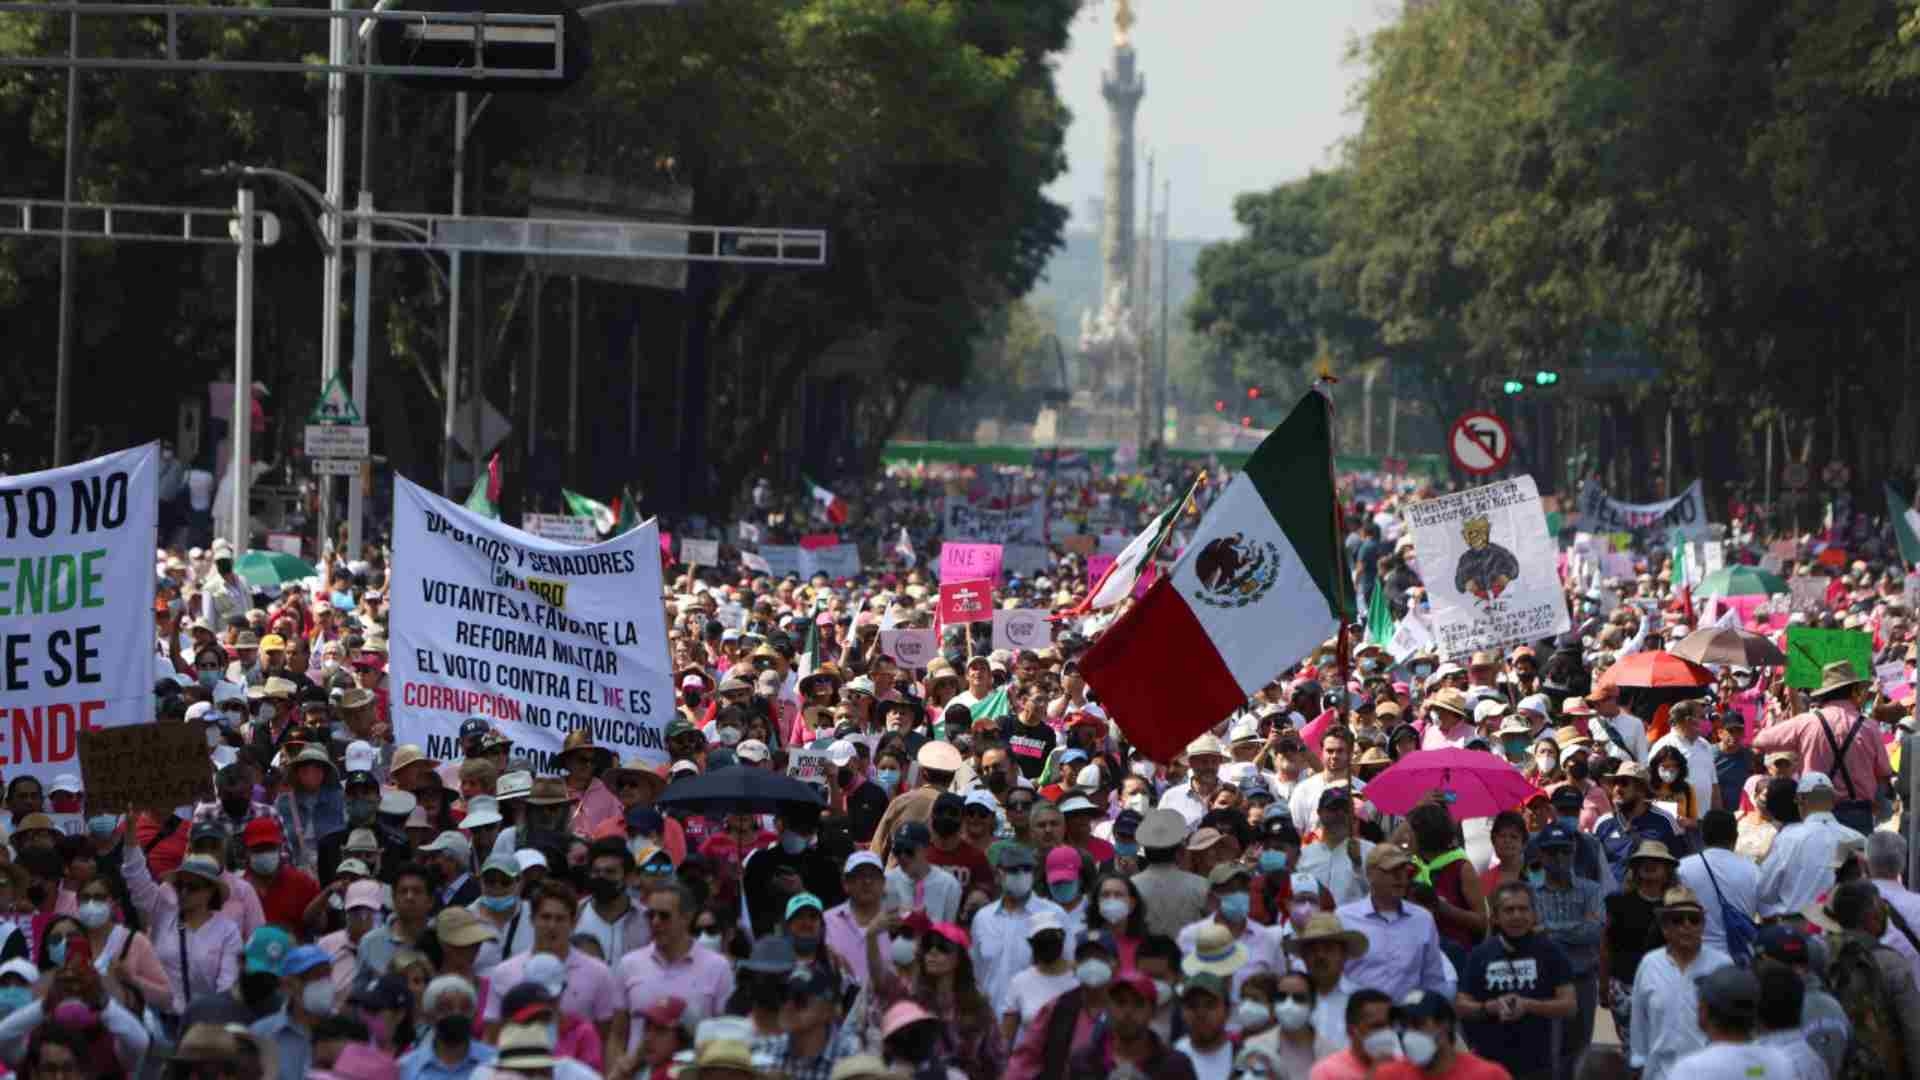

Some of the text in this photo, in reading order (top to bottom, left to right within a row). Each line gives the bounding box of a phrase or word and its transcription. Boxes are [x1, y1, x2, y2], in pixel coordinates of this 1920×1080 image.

[70, 471, 129, 535] NO
[527, 549, 635, 577] SENADORES
[422, 577, 520, 620] VOTANTES
[614, 620, 638, 646] LA
[456, 619, 547, 661] REFORMA
[44, 624, 102, 687] SE
[416, 648, 439, 675] EL
[442, 651, 491, 682] VOTO
[495, 664, 571, 700] CONTRA
[576, 678, 598, 705] EL
[629, 688, 652, 715] ES
[403, 682, 522, 724] CORRUPCIÓN
[526, 703, 552, 728] NO
